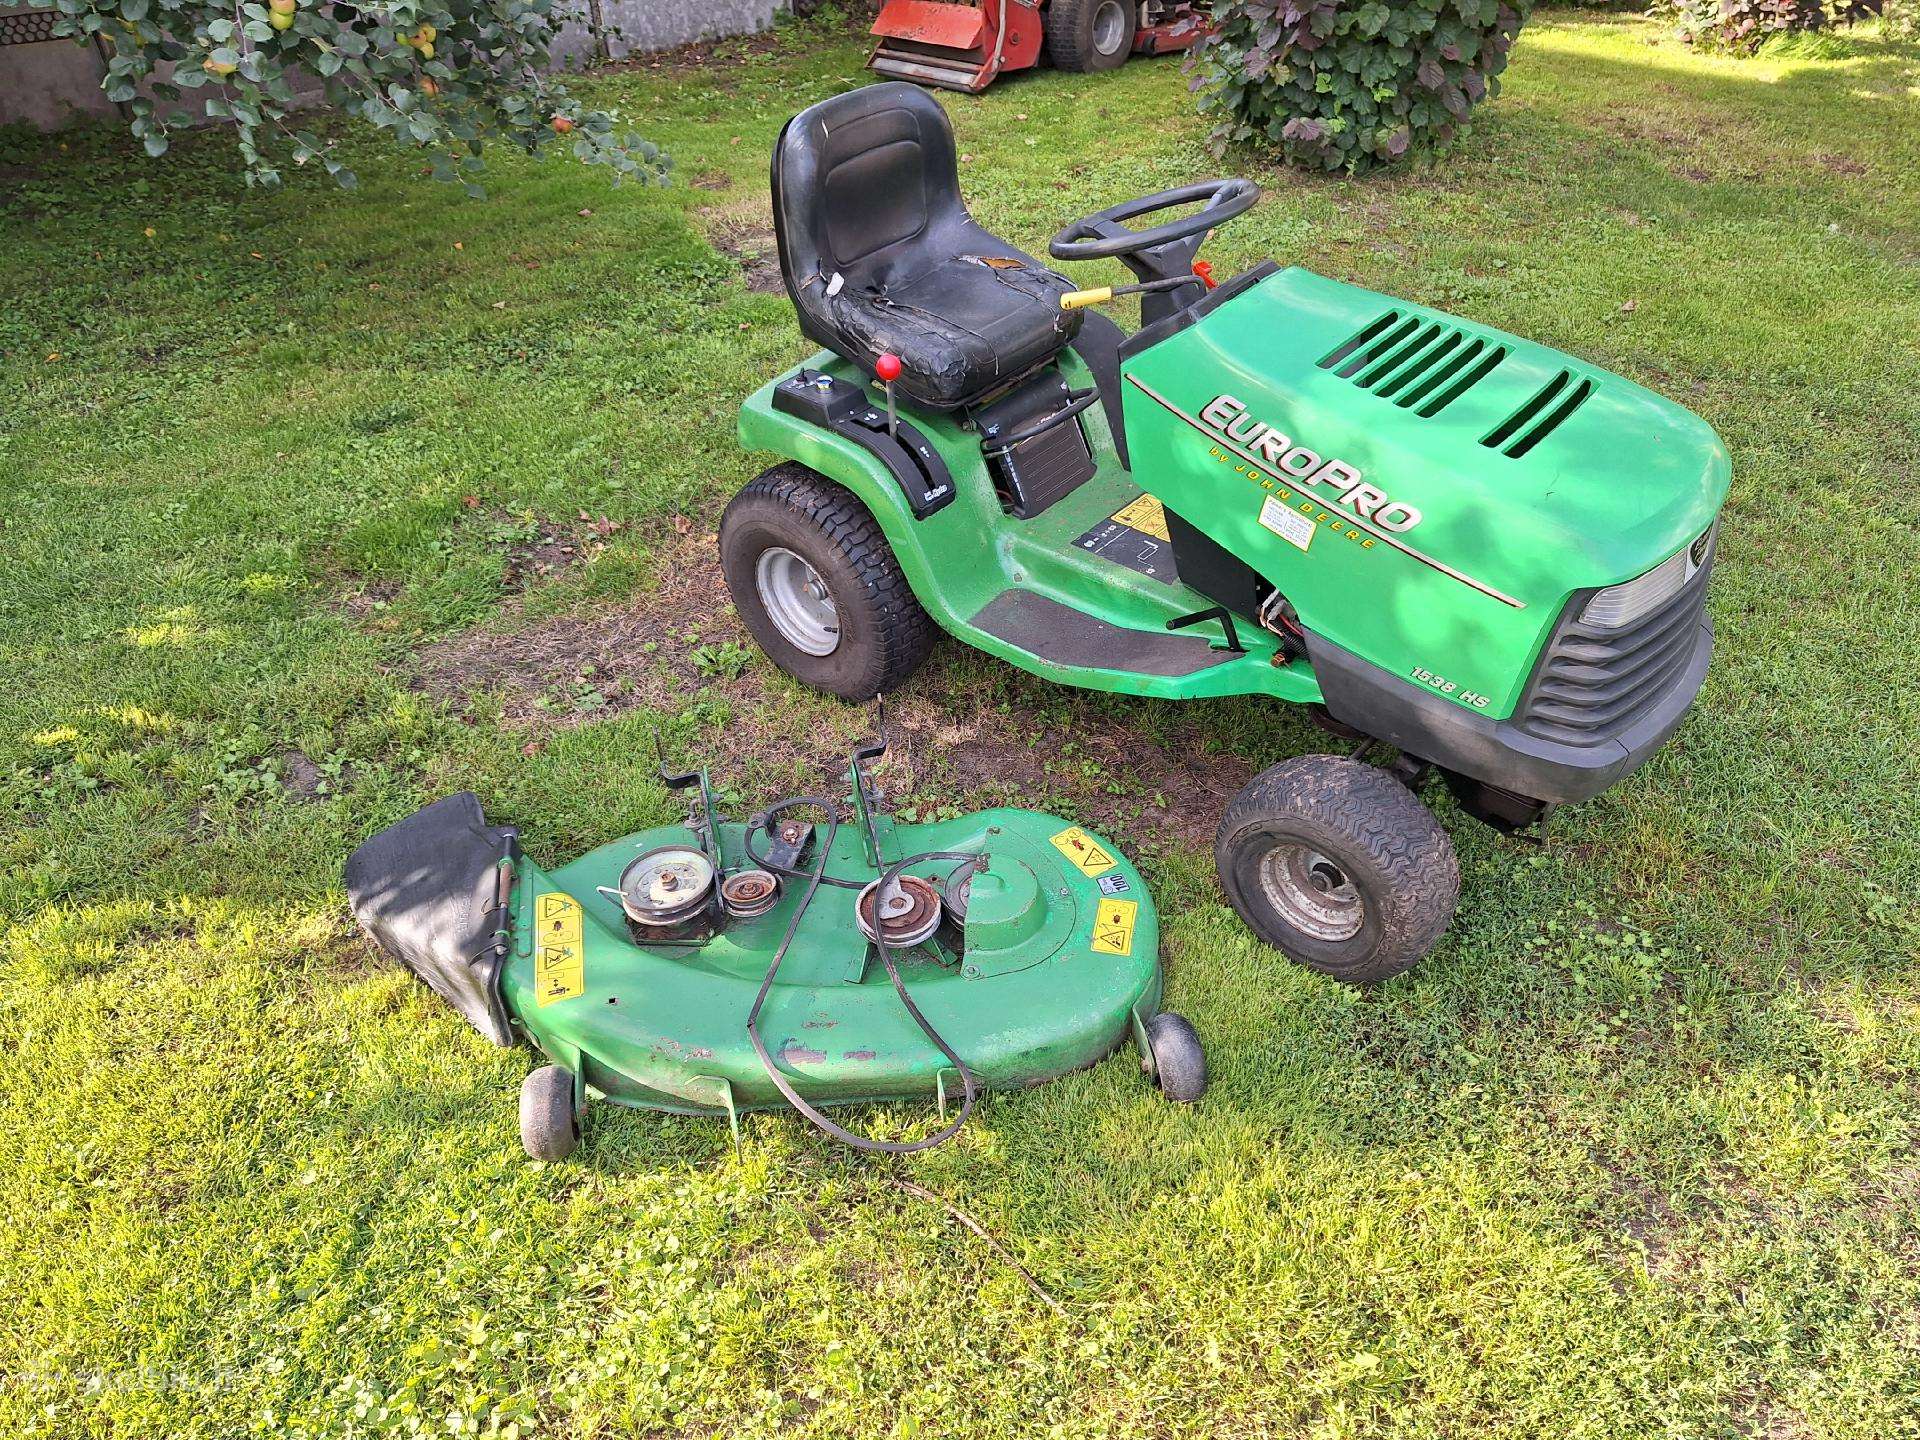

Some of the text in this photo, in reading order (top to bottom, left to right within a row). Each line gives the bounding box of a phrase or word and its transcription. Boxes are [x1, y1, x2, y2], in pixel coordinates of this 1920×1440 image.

[1208, 446, 1229, 463] by
[1234, 464, 1291, 500] JOHN
[1299, 503, 1377, 549] DEERE
[1409, 665, 1491, 708] 1538 HS
[1110, 875, 1128, 891] 100
